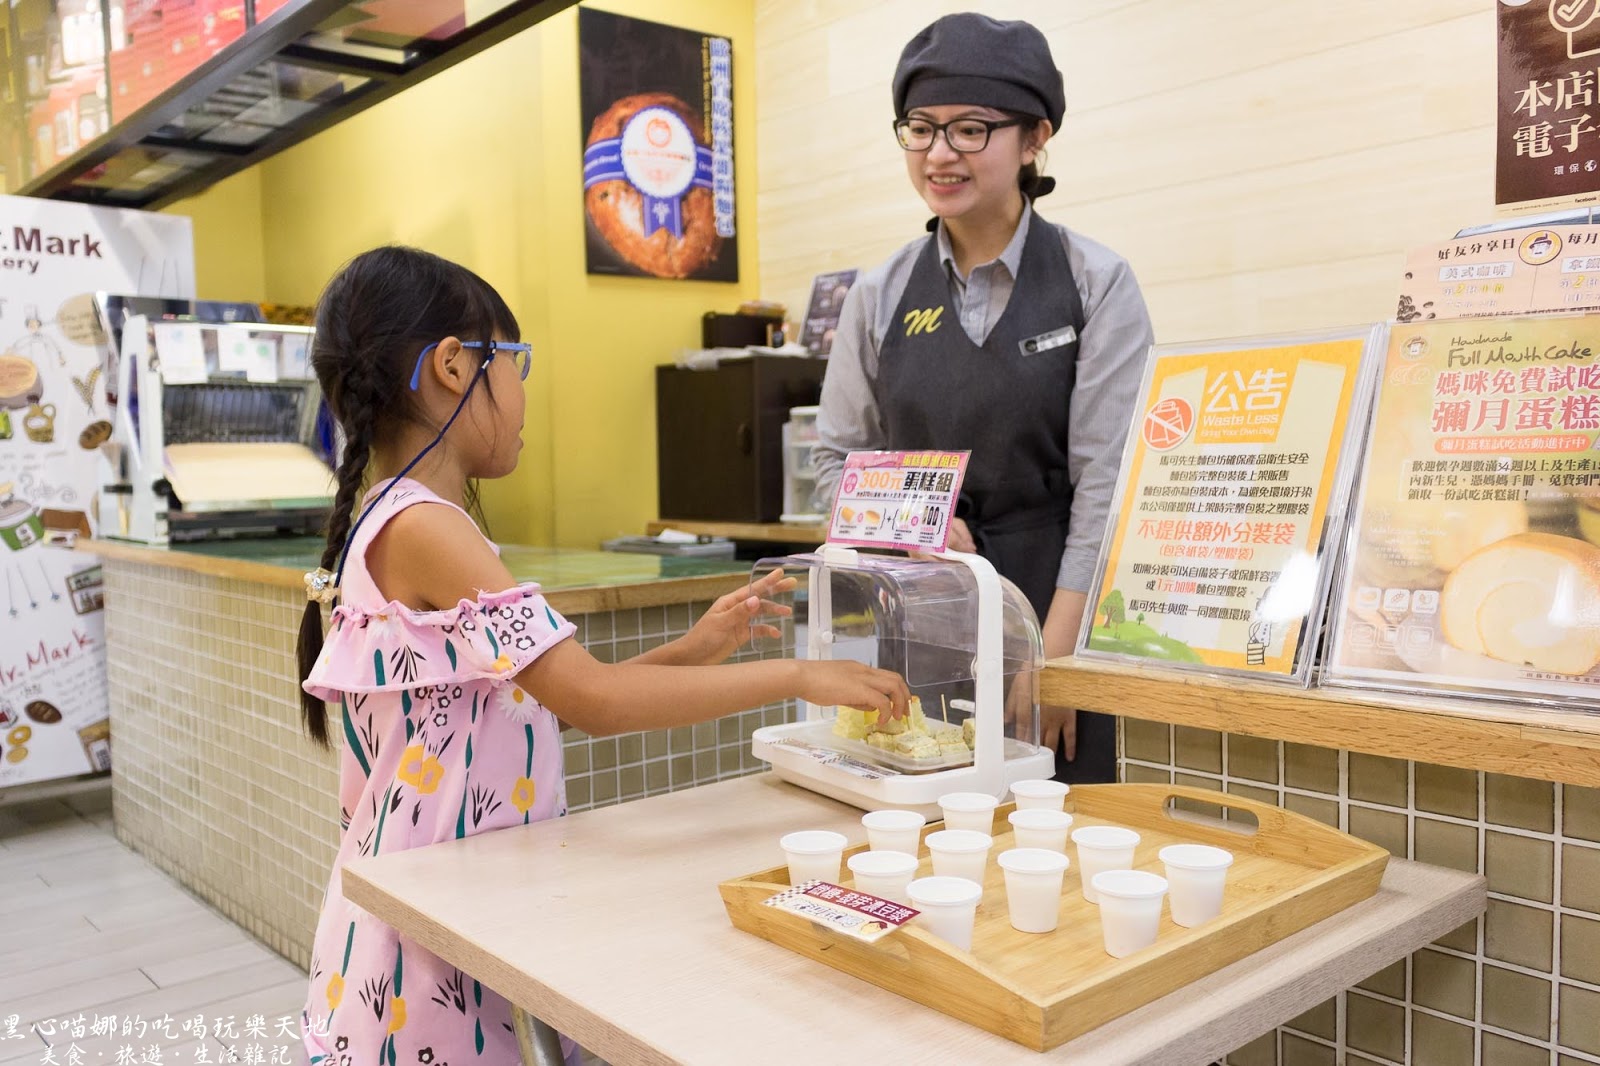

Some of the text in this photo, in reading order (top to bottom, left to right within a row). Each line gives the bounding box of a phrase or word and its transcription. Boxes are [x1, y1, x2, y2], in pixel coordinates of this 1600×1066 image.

[1513, 67, 1600, 117] 本店
[1512, 113, 1600, 158] 電子
[1553, 163, 1579, 176] 環保
[0, 226, 102, 259] .Mark
[1438, 232, 1599, 260] 好友分享日 每月
[1444, 264, 1508, 280] 美式咖啡
[903, 305, 944, 337] M
[1448, 347, 1482, 367] Full
[1544, 340, 1592, 360] Cake
[1205, 368, 1288, 413] 公告
[1435, 364, 1600, 397] 媽咪免費試吃
[1203, 413, 1279, 426] Waste Less
[1432, 395, 1600, 433] 彌月蛋糕
[1137, 519, 1296, 545] 不提供額外分裝袋
